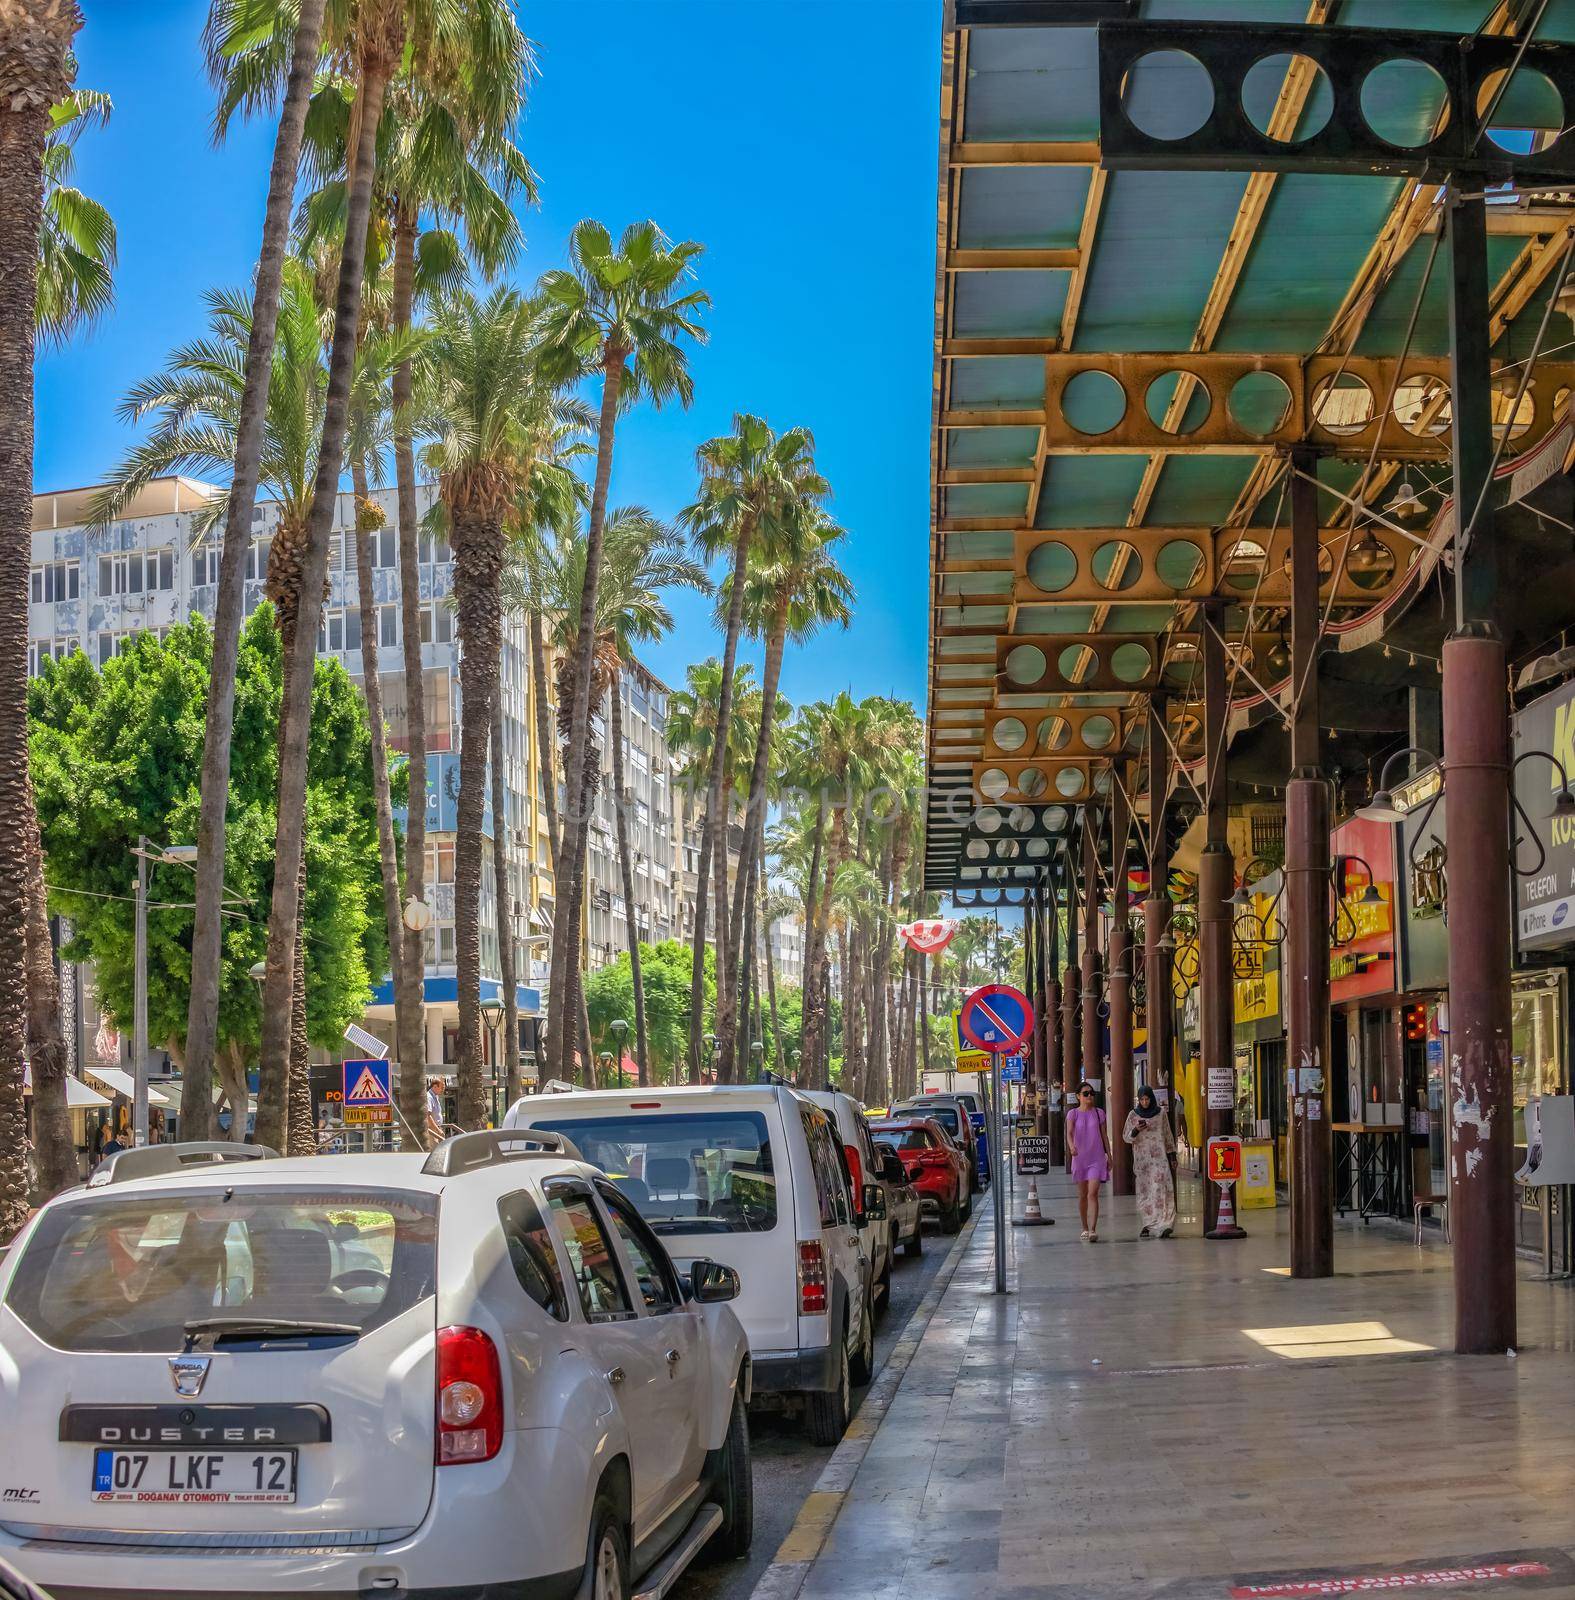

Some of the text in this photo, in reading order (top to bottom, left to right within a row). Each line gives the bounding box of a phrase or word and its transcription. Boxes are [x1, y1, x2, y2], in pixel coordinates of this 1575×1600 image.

[1525, 873, 1557, 902] TELEFON
[326, 1091, 344, 1101] PO
[1018, 1138, 1048, 1146] TATTOO
[1018, 1146, 1048, 1154] PIERCING
[100, 1426, 276, 1441] DUSTER
[99, 1455, 286, 1490] TR 07 LKF 12
[3, 1487, 40, 1498] mtr
[137, 1490, 180, 1502] DOĞANAY
[183, 1490, 231, 1502] OTOMOTİV
